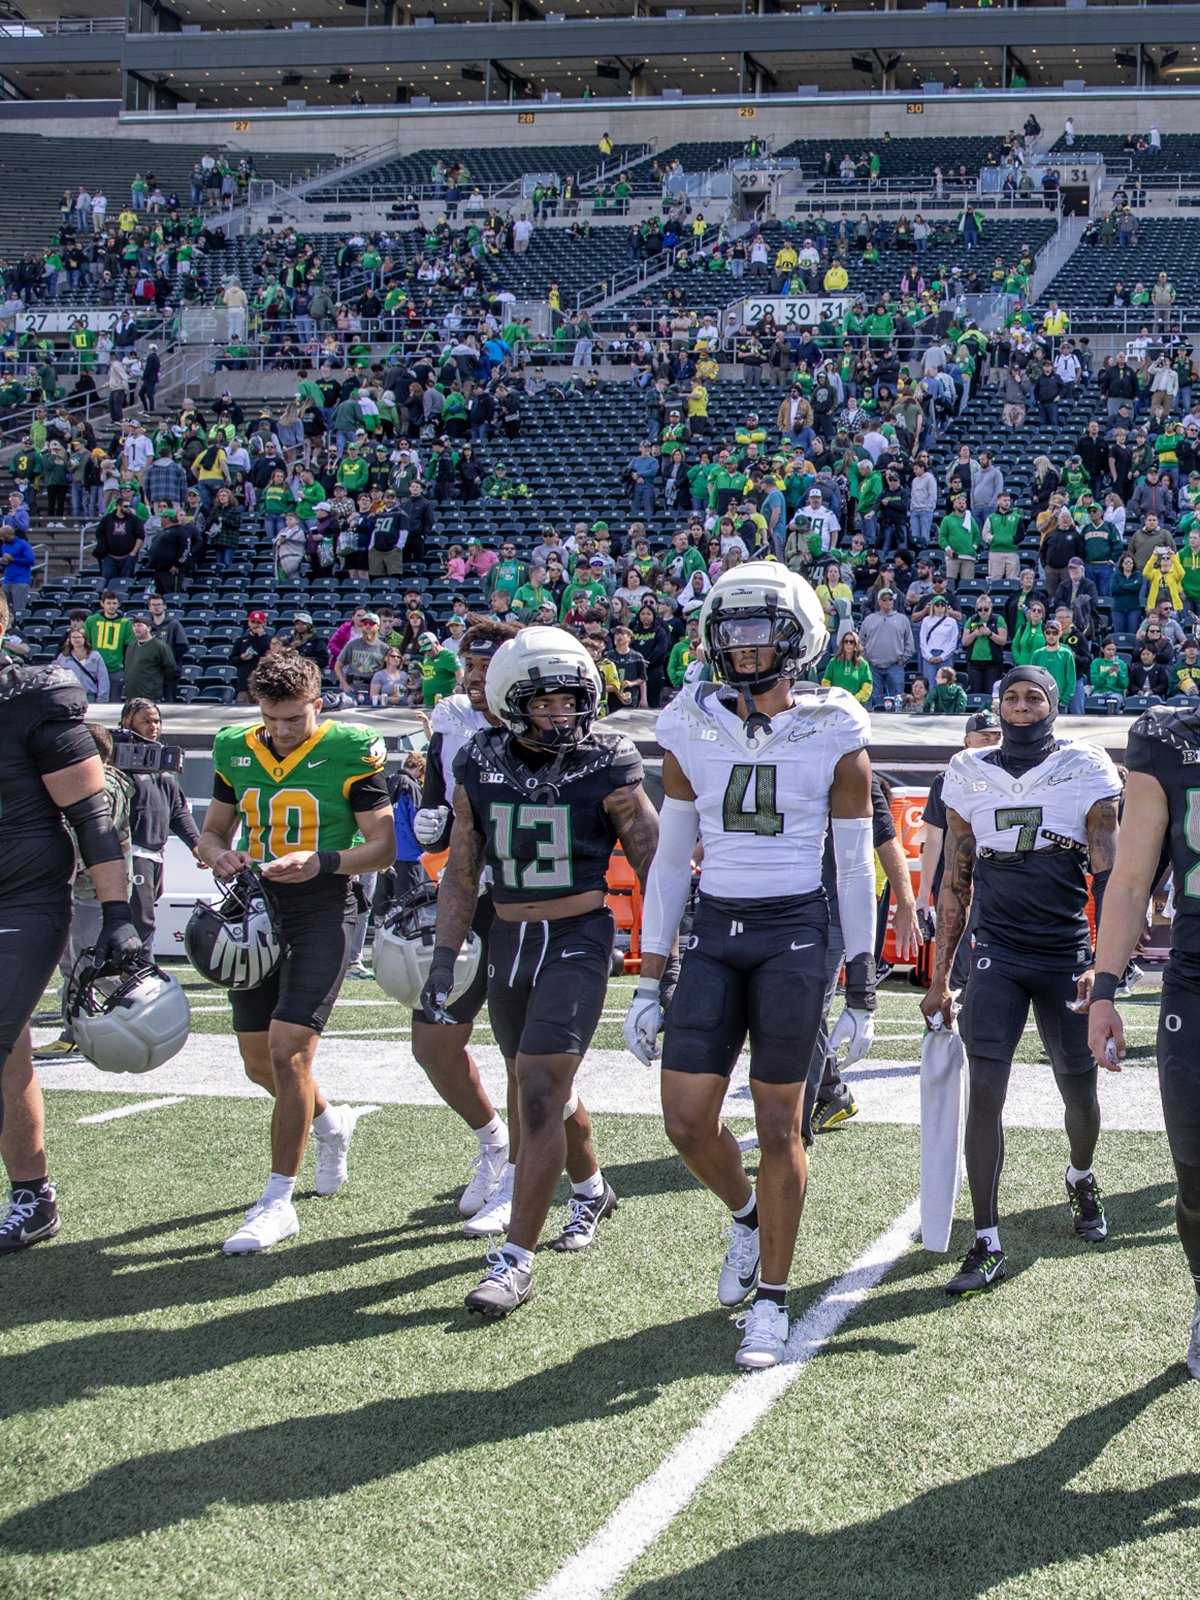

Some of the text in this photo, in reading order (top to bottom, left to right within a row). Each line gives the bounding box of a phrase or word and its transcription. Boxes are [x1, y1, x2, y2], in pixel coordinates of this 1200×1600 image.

[740, 107, 754, 117] 29
[908, 104, 923, 113] 30
[235, 121, 248, 131] 27
[520, 114, 533, 124] 28
[741, 174, 757, 188] 29
[1071, 169, 1088, 182] 31
[785, 303, 811, 321] 30
[822, 302, 844, 320] 31
[25, 315, 48, 331] 27
[67, 314, 88, 331] 28
[130, 445, 137, 461] 1
[19, 455, 28, 470] 3
[374, 517, 394, 532] 50
[96, 620, 122, 651] 10
[526, 777, 538, 790] O
[723, 764, 785, 837] 4
[240, 788, 320, 863] 10
[994, 806, 1043, 853] 7
[489, 803, 573, 889] 13
[977, 957, 991, 970] O
[1165, 1014, 1182, 1032] O
